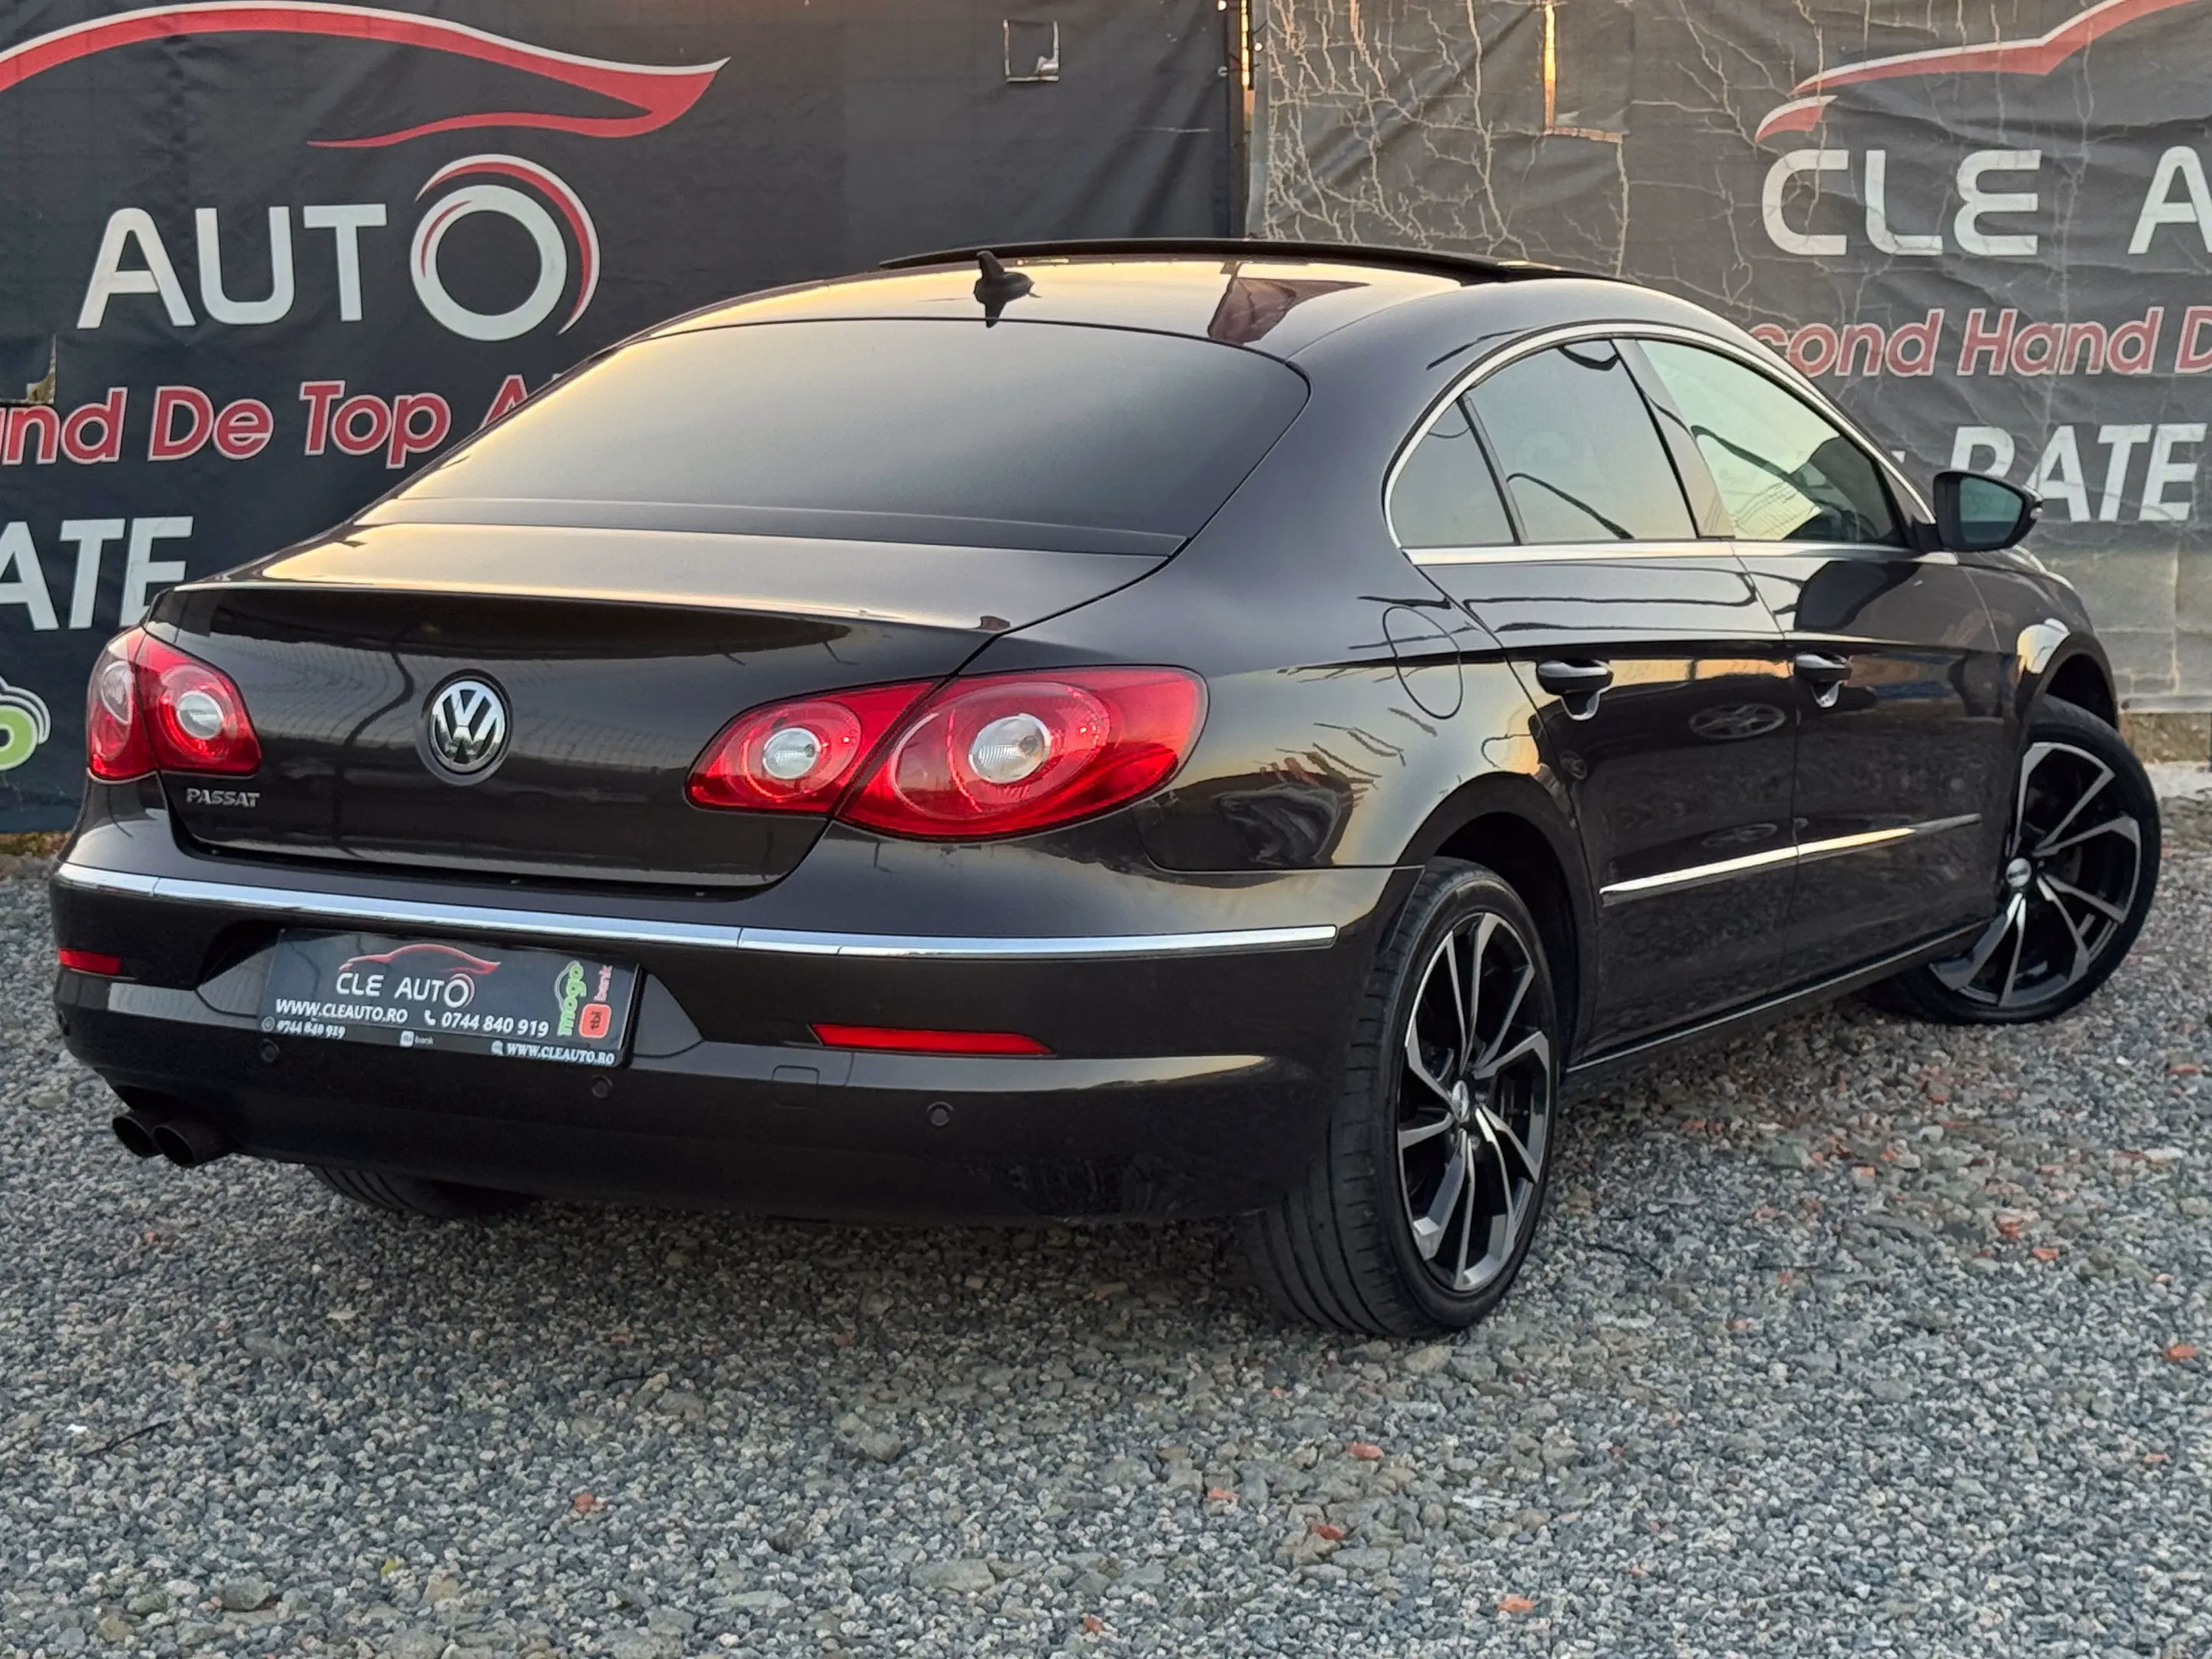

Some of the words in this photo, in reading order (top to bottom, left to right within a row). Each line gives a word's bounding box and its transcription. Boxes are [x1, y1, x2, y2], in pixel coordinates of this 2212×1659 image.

[1762, 149, 2042, 256] CLE
[77, 184, 568, 341] AUTO
[1957, 306, 2164, 377] Hand
[0, 386, 128, 465] nd
[148, 386, 273, 461] De
[300, 380, 452, 469] Top
[186, 787, 260, 808] PASSAT
[336, 972, 384, 997] CLE
[394, 975, 471, 1008] AUTO
[557, 963, 587, 1036] mogo
[593, 965, 613, 1002] bank
[276, 998, 409, 1024] WWW.CLEAUTO.RO
[441, 1011, 480, 1031] 0744
[482, 1015, 515, 1035] 840
[516, 1018, 550, 1038] 919
[276, 1019, 303, 1035] 0744
[303, 1022, 325, 1037] 840
[326, 1025, 346, 1040] 919
[506, 1042, 615, 1066] WWW.CLEAUTO.RO
